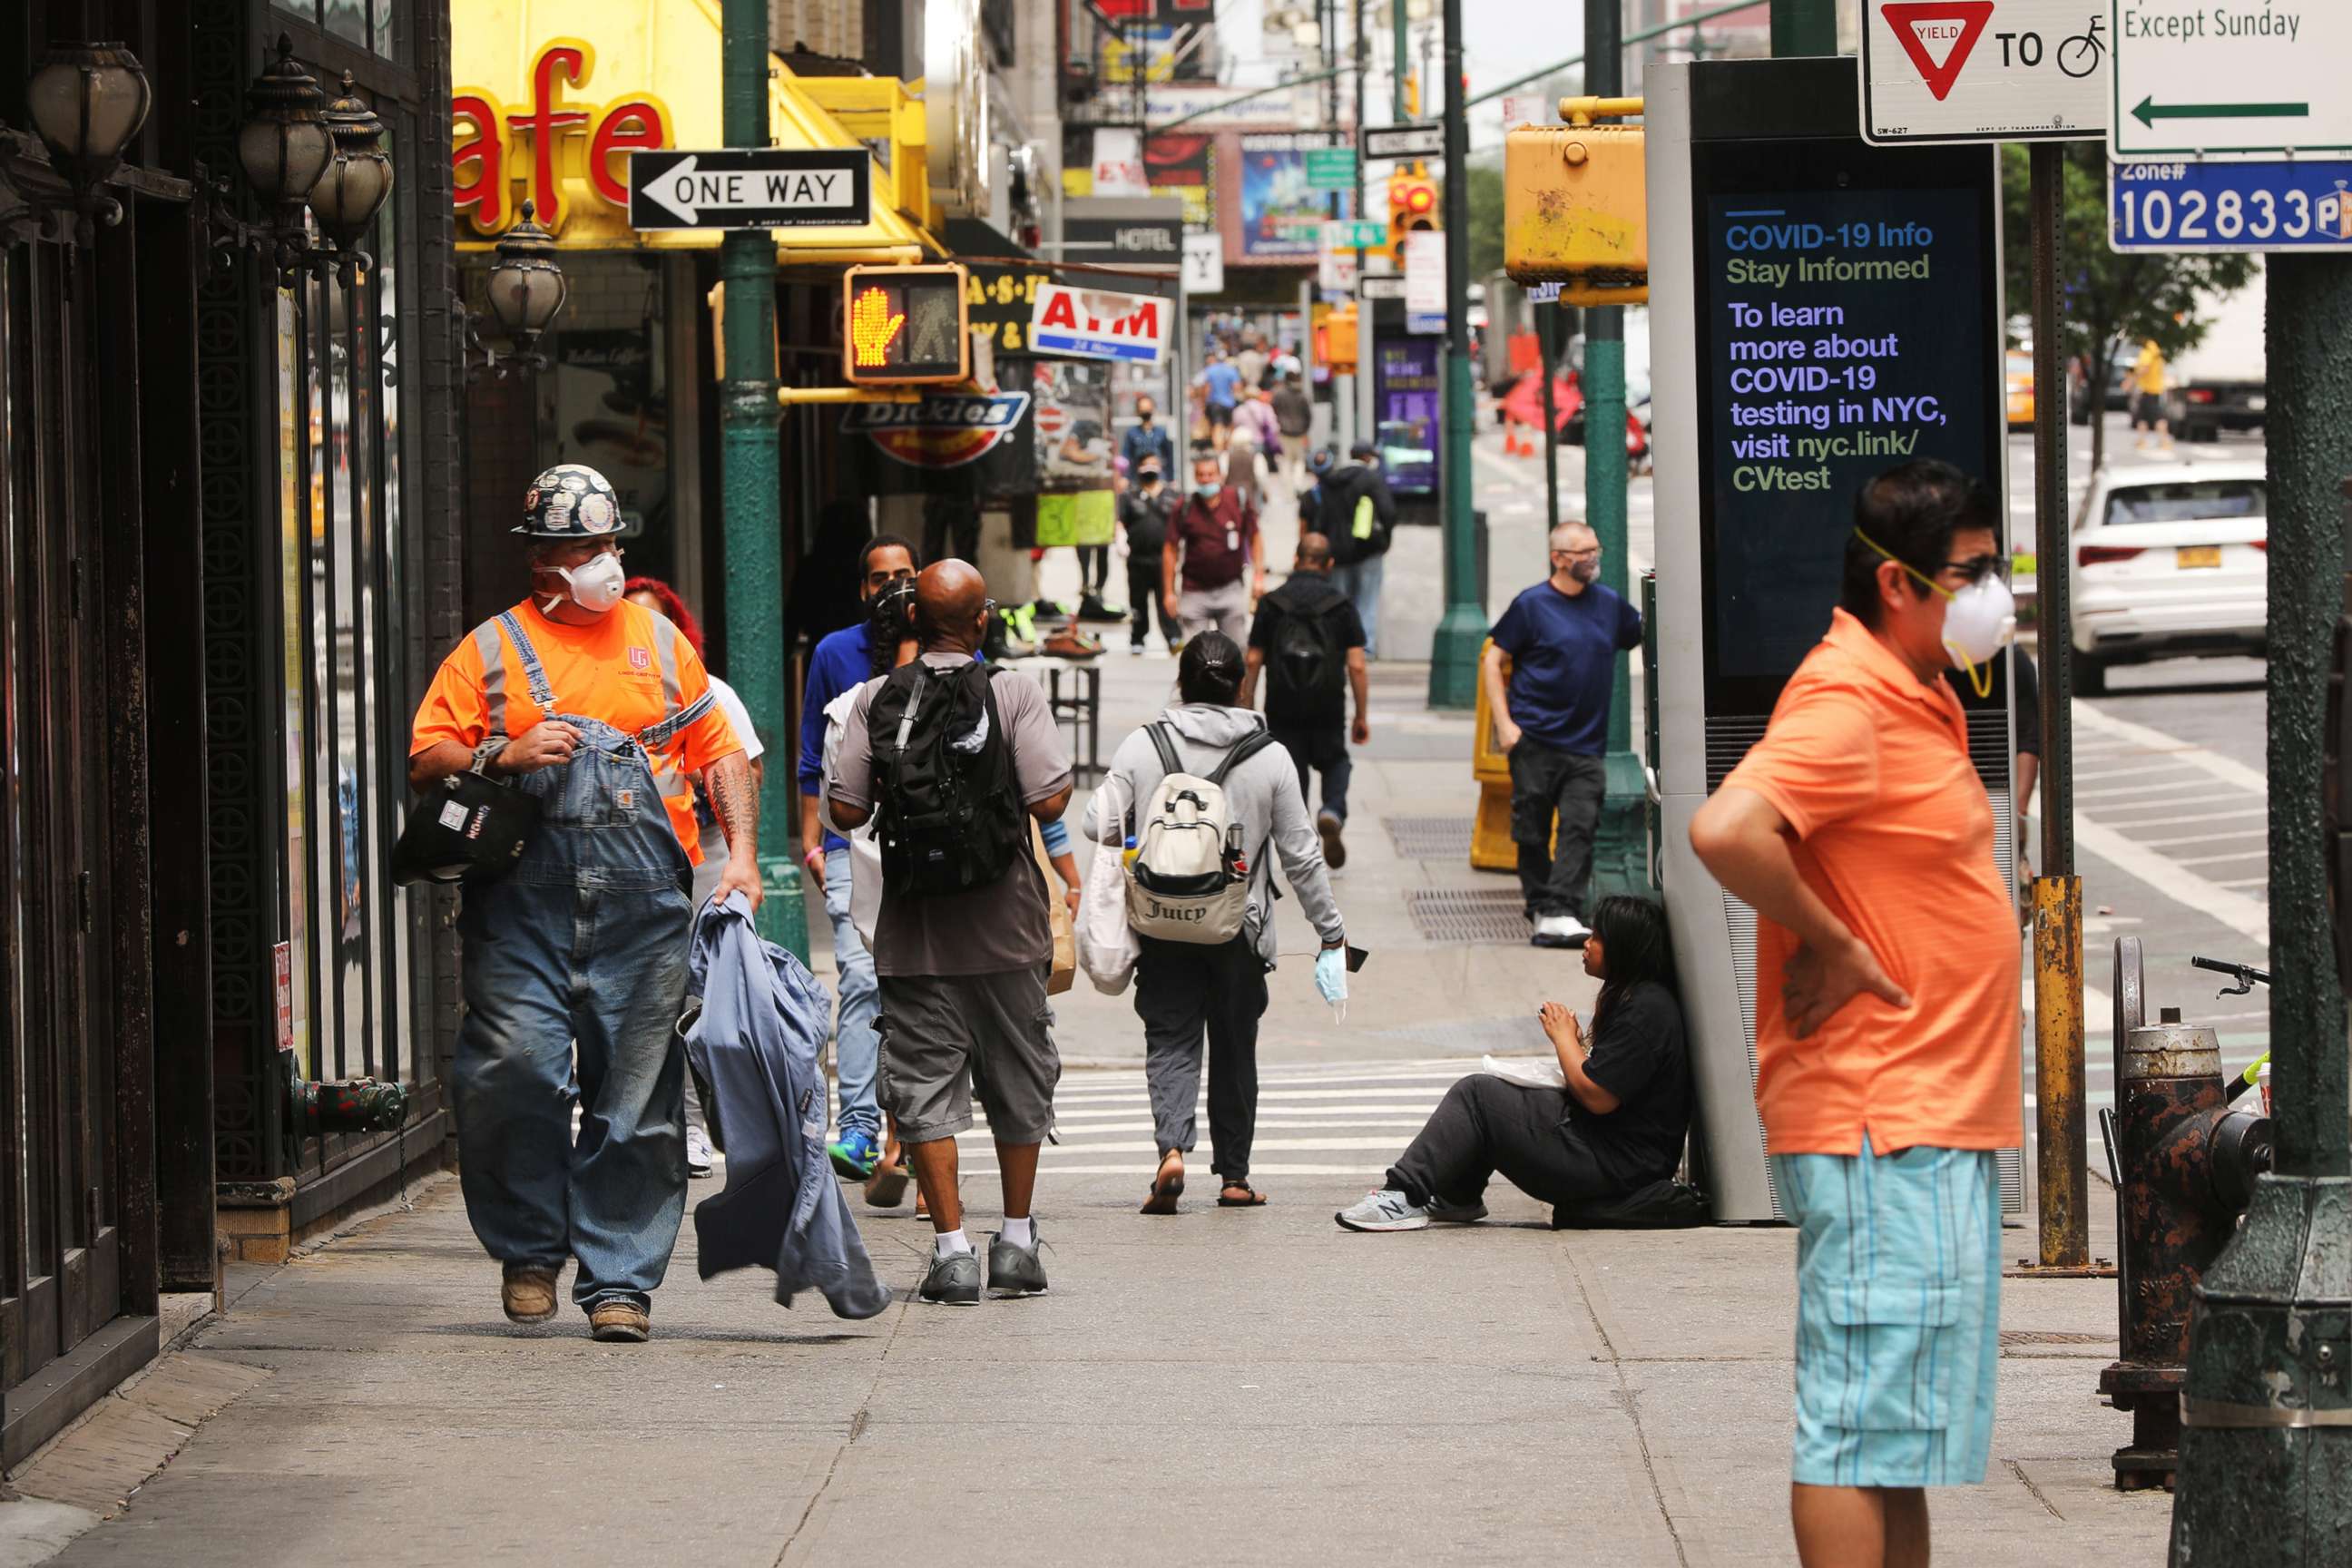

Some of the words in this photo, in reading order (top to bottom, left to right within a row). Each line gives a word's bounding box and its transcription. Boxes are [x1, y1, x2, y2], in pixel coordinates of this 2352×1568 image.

[1917, 26, 1959, 39] YIELD
[2125, 9, 2205, 43] Except
[2214, 8, 2299, 42] Sunday
[1995, 32, 2043, 67] TO
[1877, 127, 1908, 135] SW-627
[2121, 163, 2187, 181] Zone#
[675, 176, 744, 203] ONE
[765, 174, 836, 202] WAY
[2122, 189, 2311, 240] 102833
[1115, 228, 1177, 251] HOTEL
[1726, 223, 1871, 250] COVID-19
[1878, 221, 1934, 247] Info
[1727, 258, 1790, 289] Stay
[1798, 254, 1930, 282] Informed
[1728, 302, 1763, 328] To
[1771, 302, 1844, 327] learn
[1002, 322, 1023, 349] &
[1730, 339, 1806, 360] more
[1814, 333, 1898, 358] about
[1730, 365, 1877, 394] COVID-19
[1730, 400, 1830, 429] testing
[1838, 398, 1864, 423] in
[1872, 396, 1947, 426] NYC,
[1731, 433, 1790, 458] visit
[1798, 428, 1919, 462] nyc.link/
[1733, 466, 1831, 492] CVtest
[1144, 897, 1207, 925] Juicy
